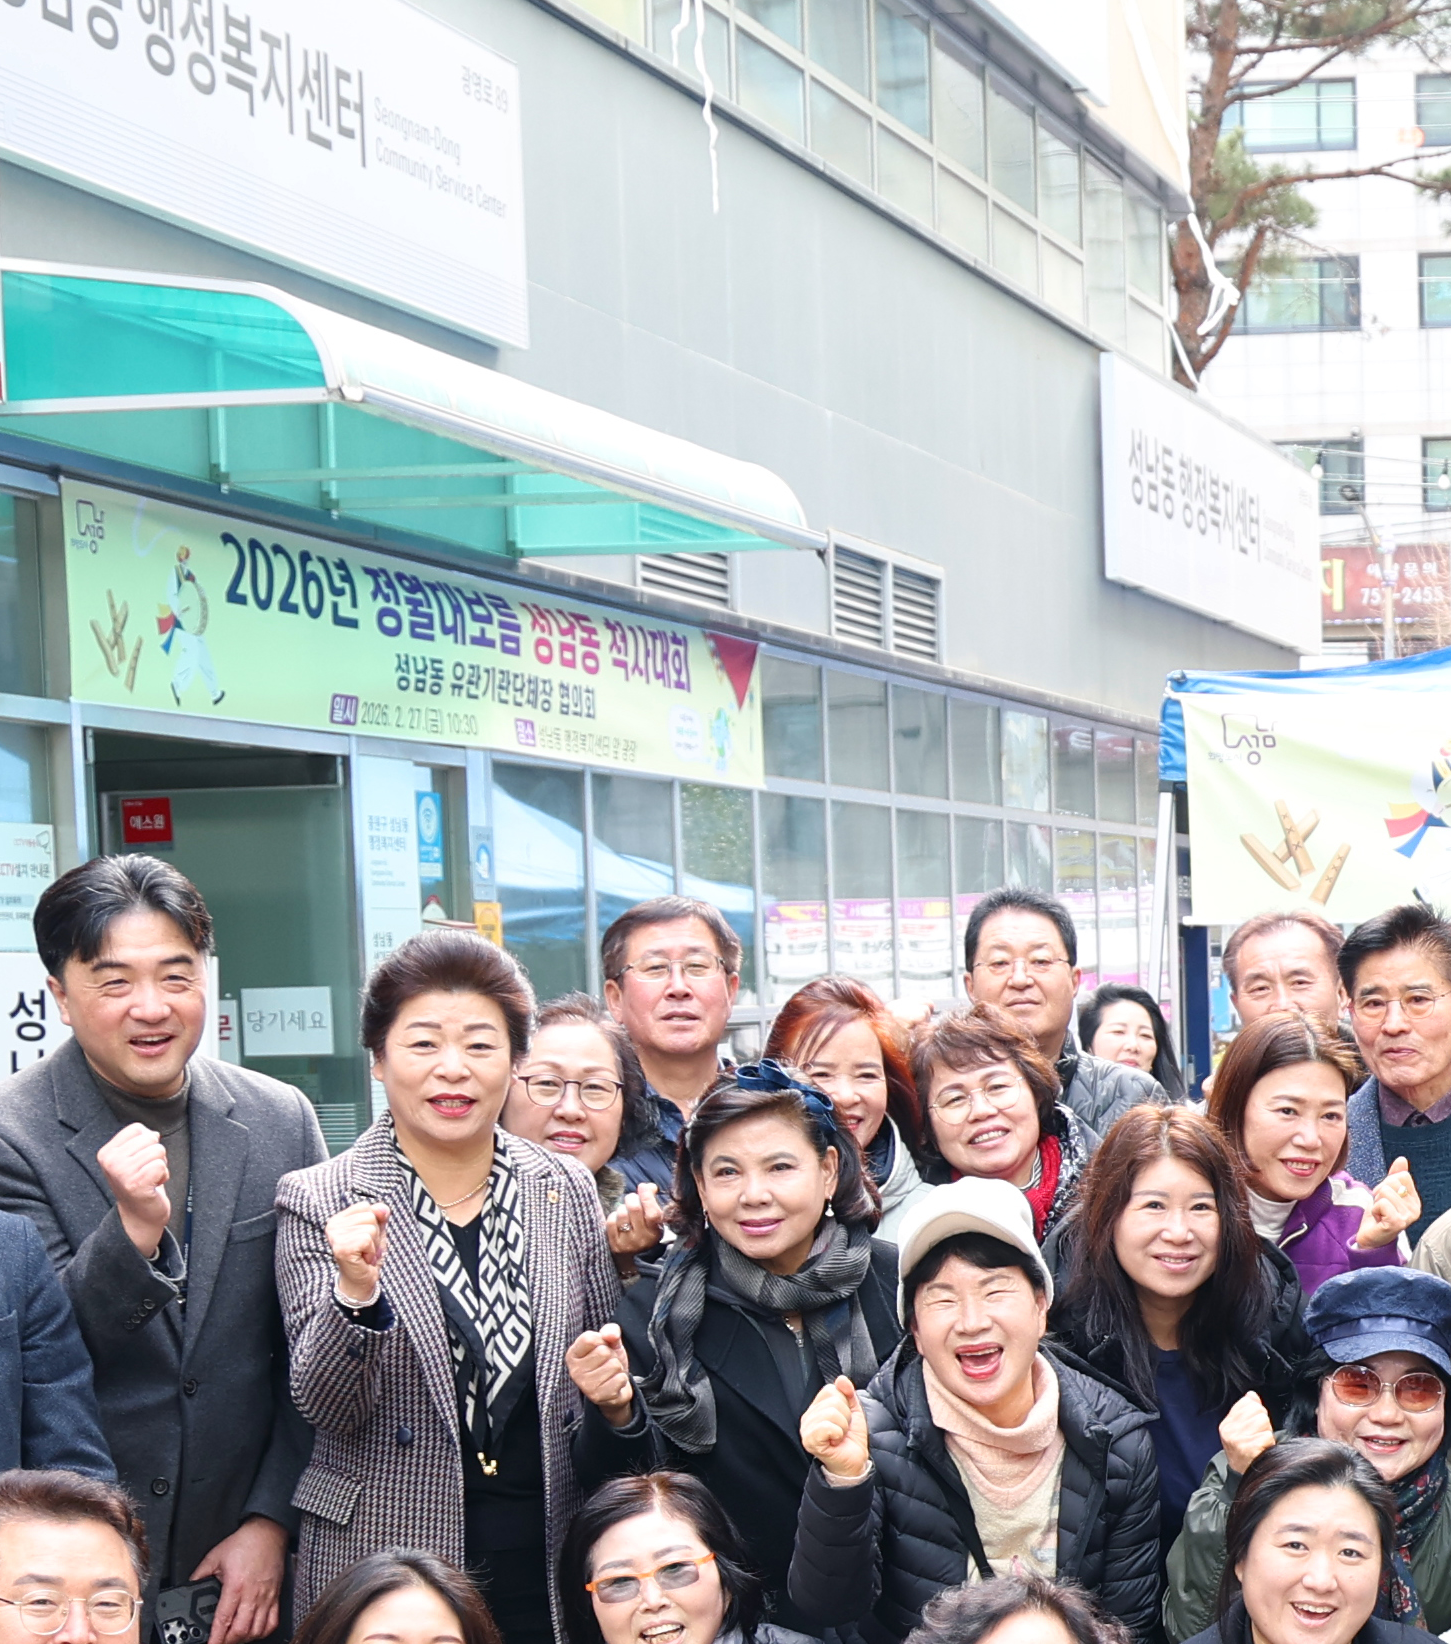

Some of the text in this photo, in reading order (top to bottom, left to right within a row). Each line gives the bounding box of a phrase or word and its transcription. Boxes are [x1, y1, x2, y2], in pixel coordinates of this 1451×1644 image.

[374, 96, 461, 166] Seongnam-Dong
[375, 137, 508, 219] Community Service Center
[1128, 427, 1176, 520] 성남동
[1178, 453, 1261, 563] 행정복지센터
[220, 532, 691, 693] 2026년 정월대보름 성남동 척사대회
[332, 696, 356, 724] 일시
[395, 653, 596, 719] 성남동 유관기관단체장 협의회
[361, 701, 391, 725] 2026.
[395, 705, 405, 727] 2.
[446, 713, 478, 735] 10:30
[368, 835, 407, 852] 행정복지센터
[389, 817, 409, 833] 성남동
[246, 1009, 327, 1033] 당기세요
